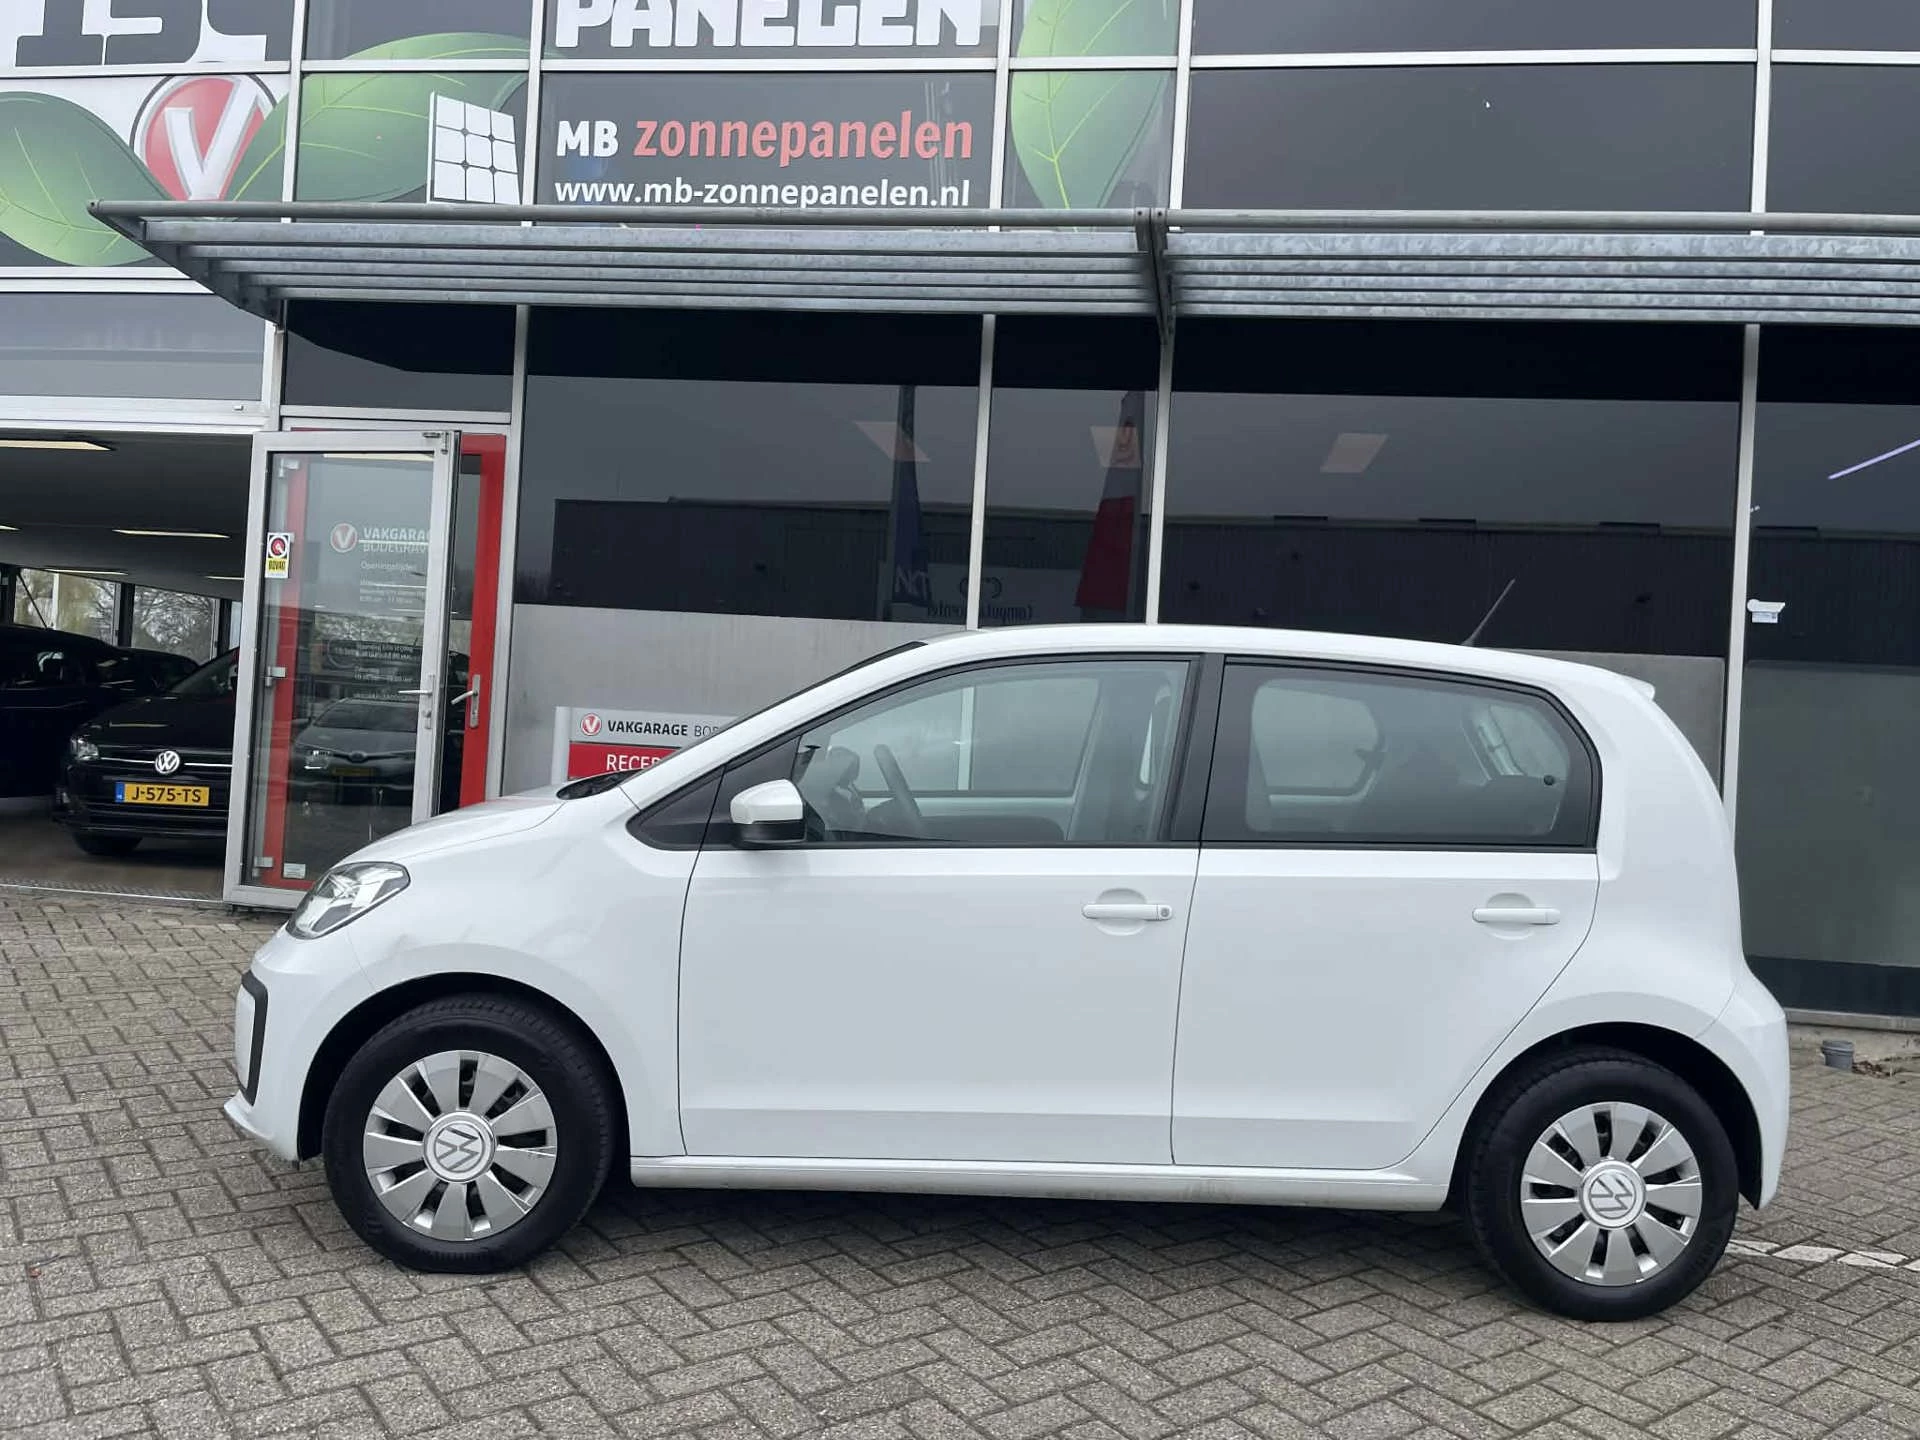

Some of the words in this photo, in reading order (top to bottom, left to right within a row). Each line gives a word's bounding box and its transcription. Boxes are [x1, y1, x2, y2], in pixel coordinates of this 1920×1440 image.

[555, 119, 619, 157] MB
[633, 111, 973, 168] zonnepanelen
[554, 177, 970, 208] www.mb-zonnepanelen.nl
[607, 719, 689, 737] VAKGARAGE
[131, 786, 202, 803] J-575-TS
